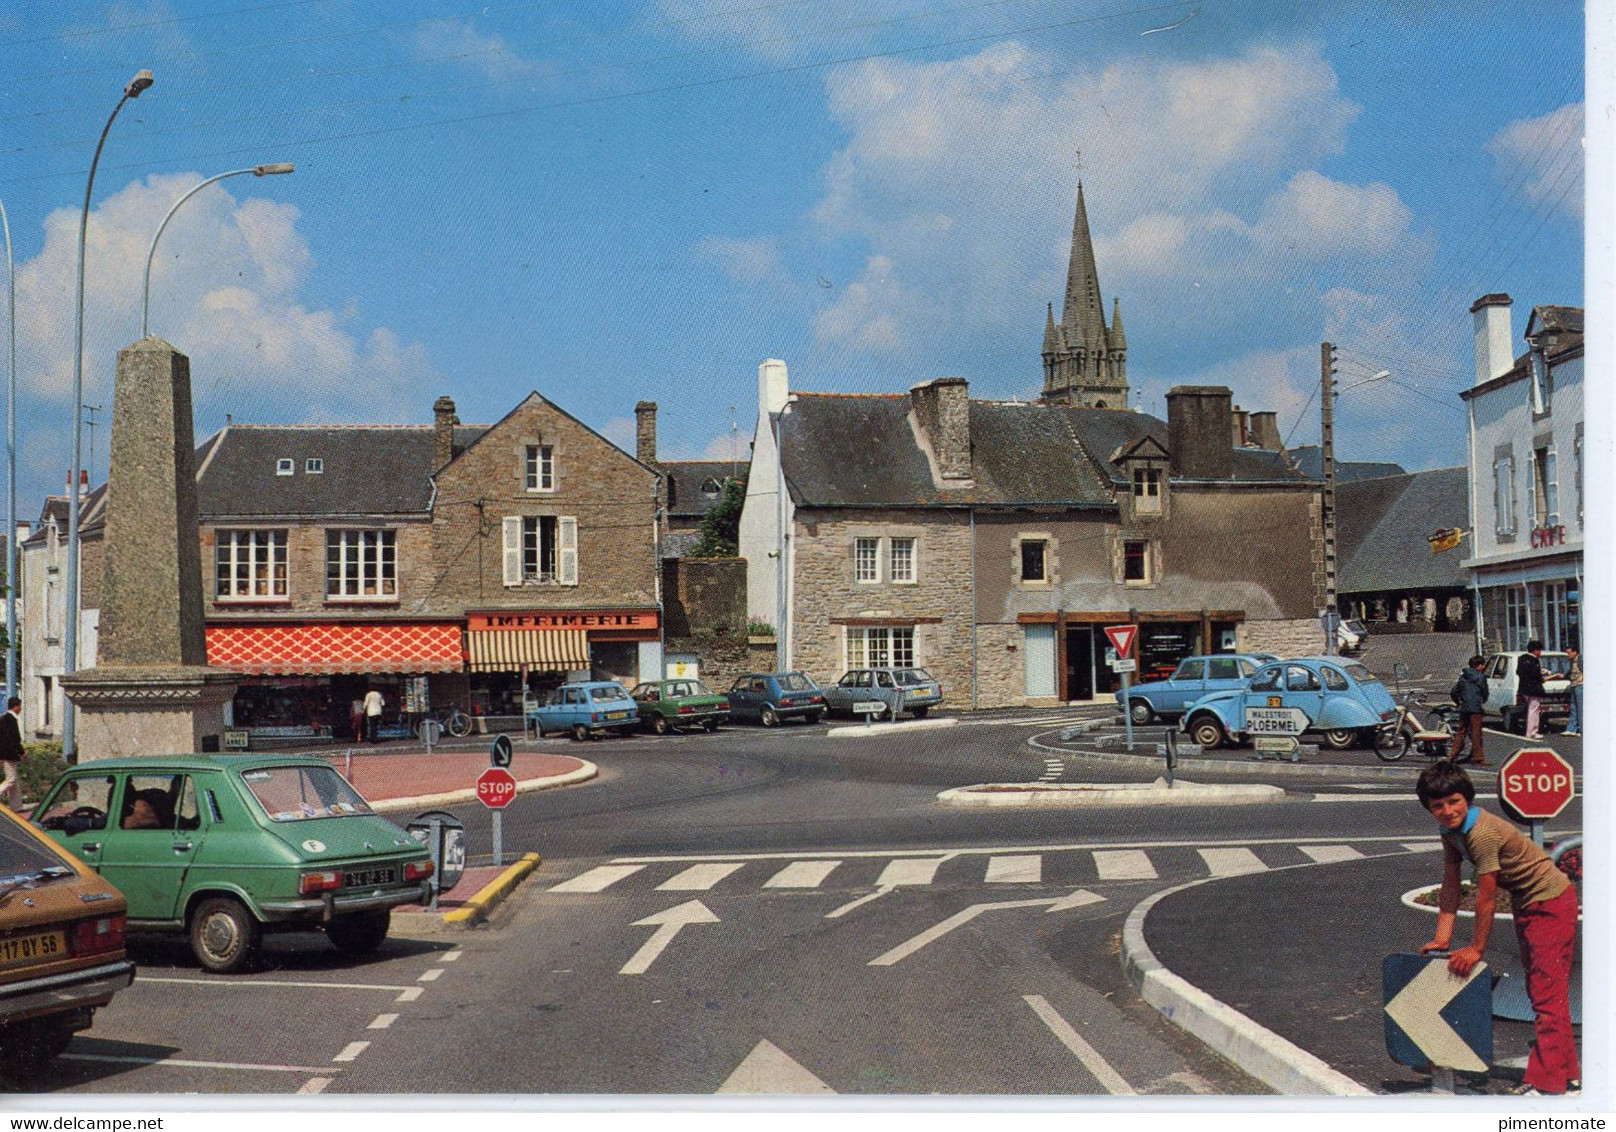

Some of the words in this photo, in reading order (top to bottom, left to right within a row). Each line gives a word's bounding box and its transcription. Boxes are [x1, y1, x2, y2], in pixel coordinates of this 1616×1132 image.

[486, 615, 641, 627] IMPRIMERIE
[1252, 710, 1292, 719] MALESTROIT
[479, 782, 513, 794] STOP
[1508, 774, 1567, 793] STOP
[0, 940, 18, 960] 17
[41, 934, 57, 954] 56
